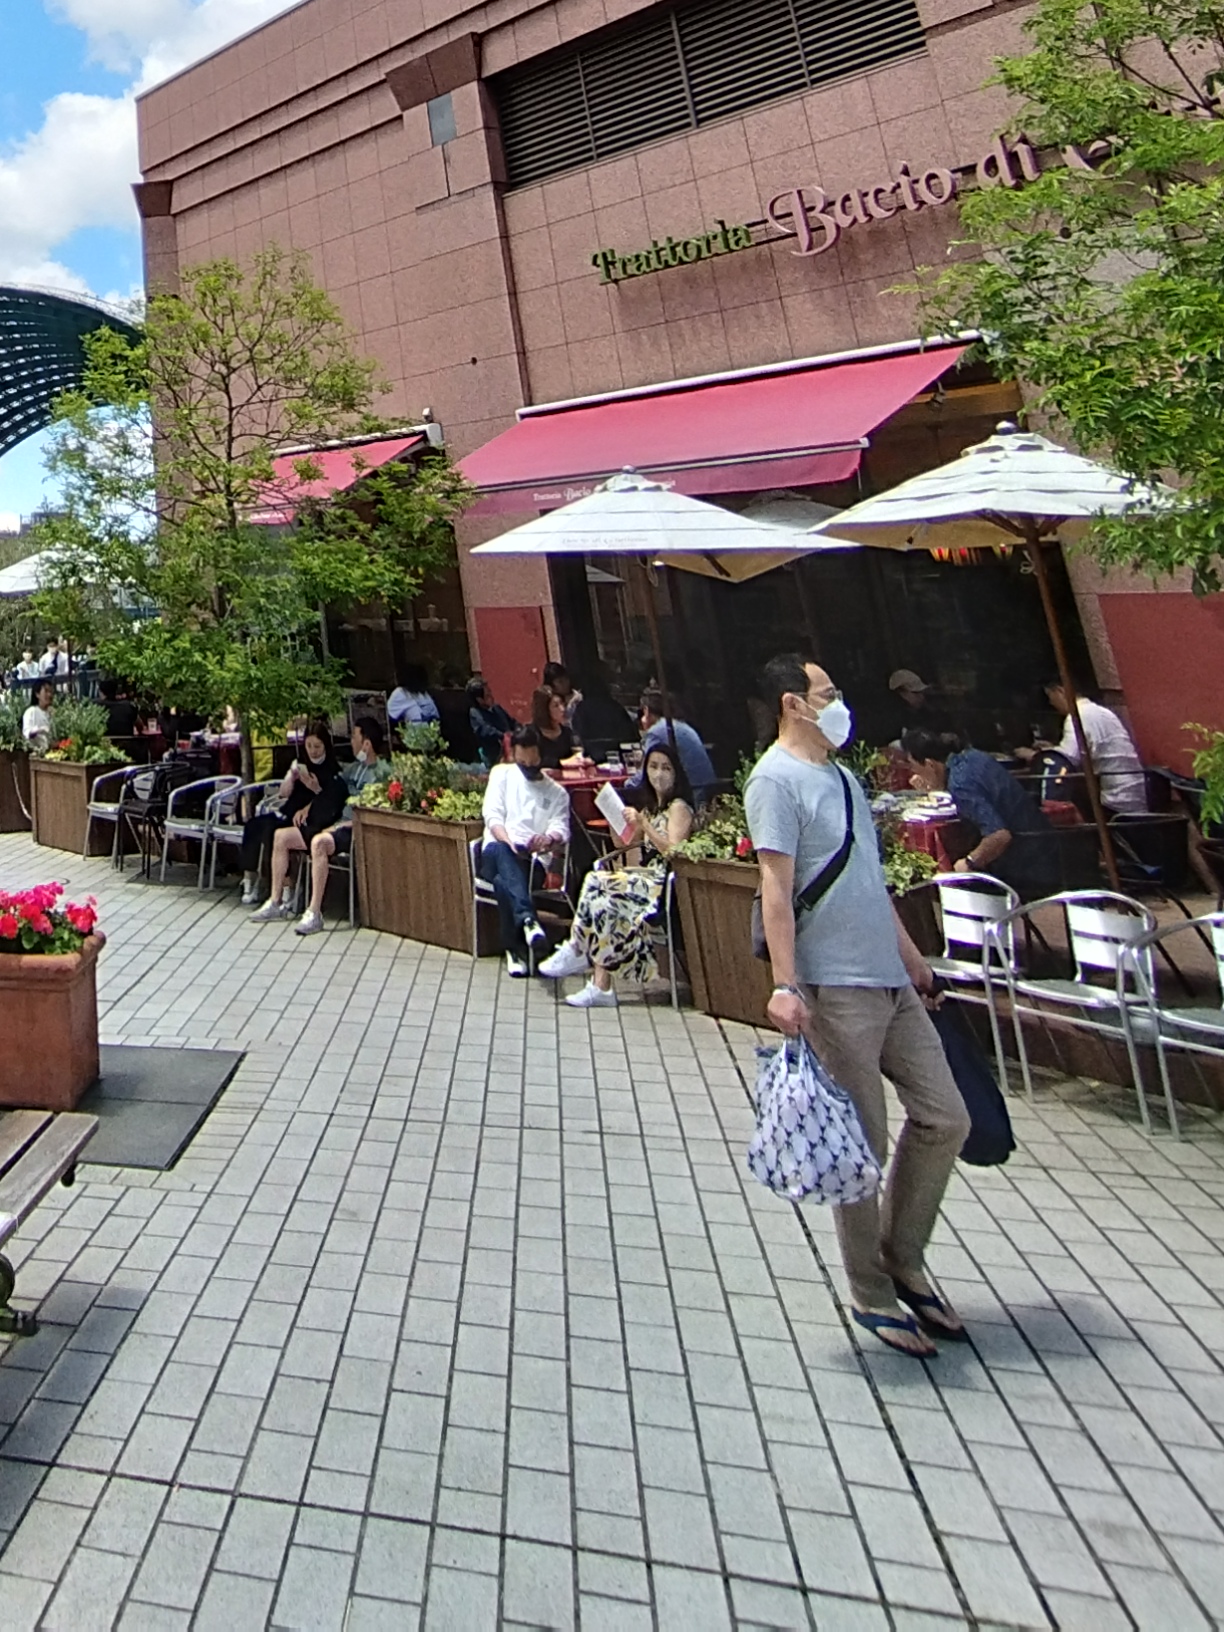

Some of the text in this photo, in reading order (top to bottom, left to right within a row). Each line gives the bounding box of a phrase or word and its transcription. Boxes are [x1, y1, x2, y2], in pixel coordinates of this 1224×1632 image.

[591, 219, 753, 285] Trattoria
[768, 162, 959, 257] Bacio
[976, 131, 1042, 192] di
